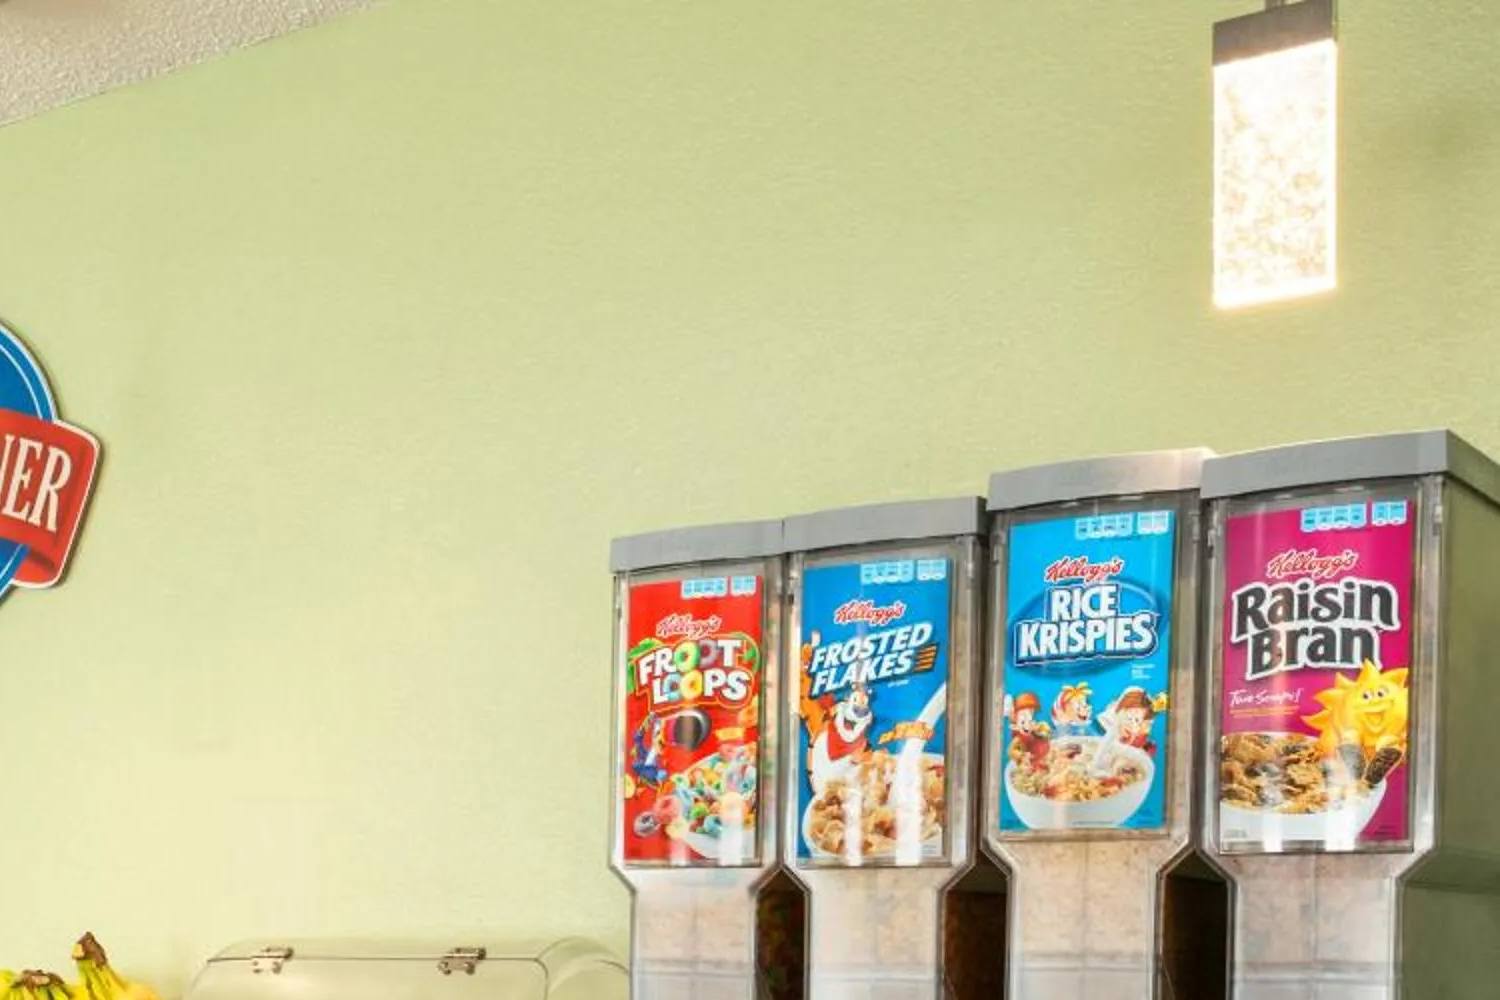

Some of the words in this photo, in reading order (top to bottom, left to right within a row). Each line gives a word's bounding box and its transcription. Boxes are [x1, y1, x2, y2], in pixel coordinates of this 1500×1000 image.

[1045, 556, 1124, 584] Kellogg's
[1266, 549, 1359, 579] Kellogg's
[834, 600, 906, 626] Kellogg's
[1051, 585, 1117, 621] RICE
[1234, 580, 1397, 638] Raisin
[810, 623, 932, 673] FROSTED
[1018, 613, 1153, 658] KRISPIES
[1250, 625, 1377, 676] Bran
[639, 639, 742, 686] FROOT
[812, 650, 914, 696] FLAKES
[652, 668, 751, 704] LOOPS
